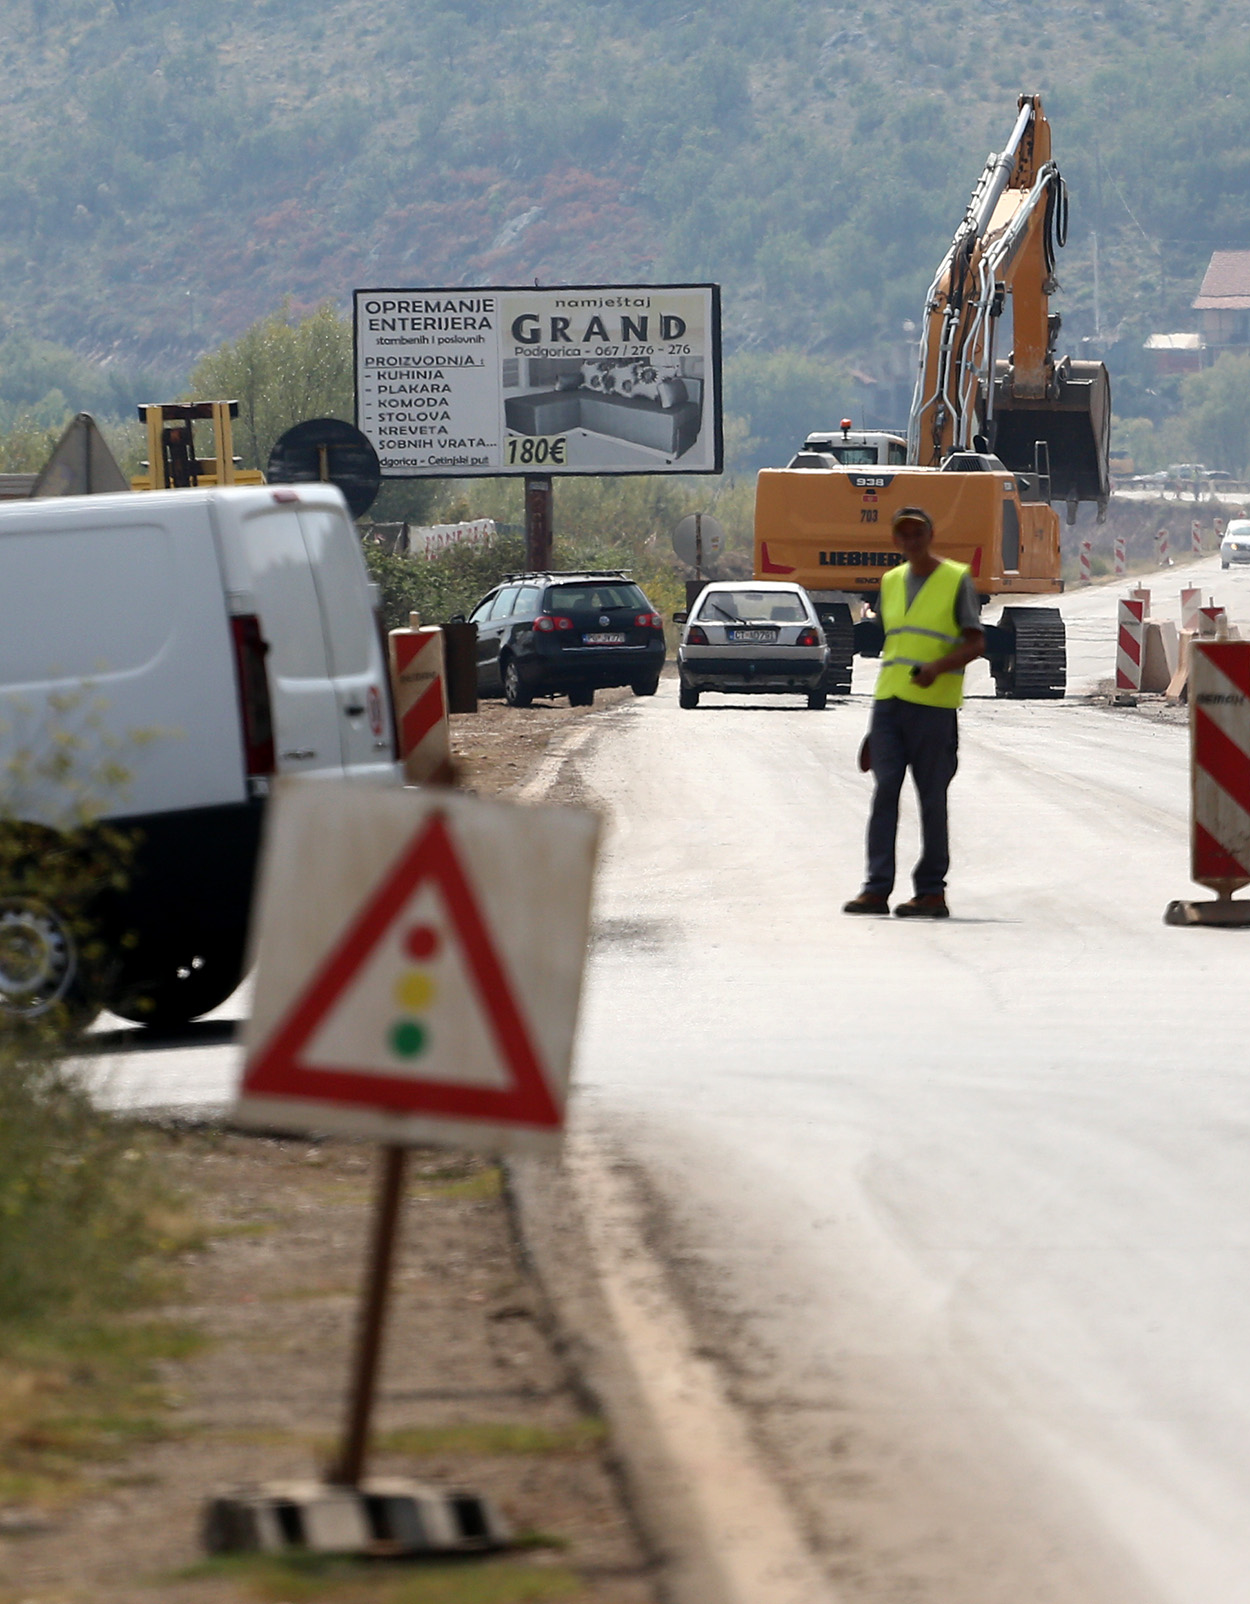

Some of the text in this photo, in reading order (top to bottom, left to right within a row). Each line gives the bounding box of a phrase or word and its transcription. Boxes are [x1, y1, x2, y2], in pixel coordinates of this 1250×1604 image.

[365, 299, 495, 314] OPREMANJE
[555, 296, 651, 308] namještaj
[368, 316, 493, 331] ENTERIJERA
[511, 312, 687, 345] GRAND
[376, 335, 429, 345] stambenih
[438, 334, 485, 346] poslovnih
[514, 346, 581, 359] Podgorica
[595, 346, 619, 356] 067
[631, 345, 654, 356] 276
[668, 344, 691, 355] 276
[365, 355, 475, 367] PROIZVODNJA
[377, 370, 444, 381] KUHINJA
[378, 384, 452, 395] PLAKARA
[378, 397, 449, 408] KOMODA
[378, 411, 451, 422] STOLOVA
[378, 425, 448, 436] KREVETA
[379, 440, 433, 450] SOBNIH
[508, 438, 566, 464] 180€
[380, 456, 417, 468] dgorica
[471, 456, 489, 466] put
[856, 478, 884, 487] 938
[860, 509, 878, 523] 703
[819, 551, 907, 566] LIEBHER
